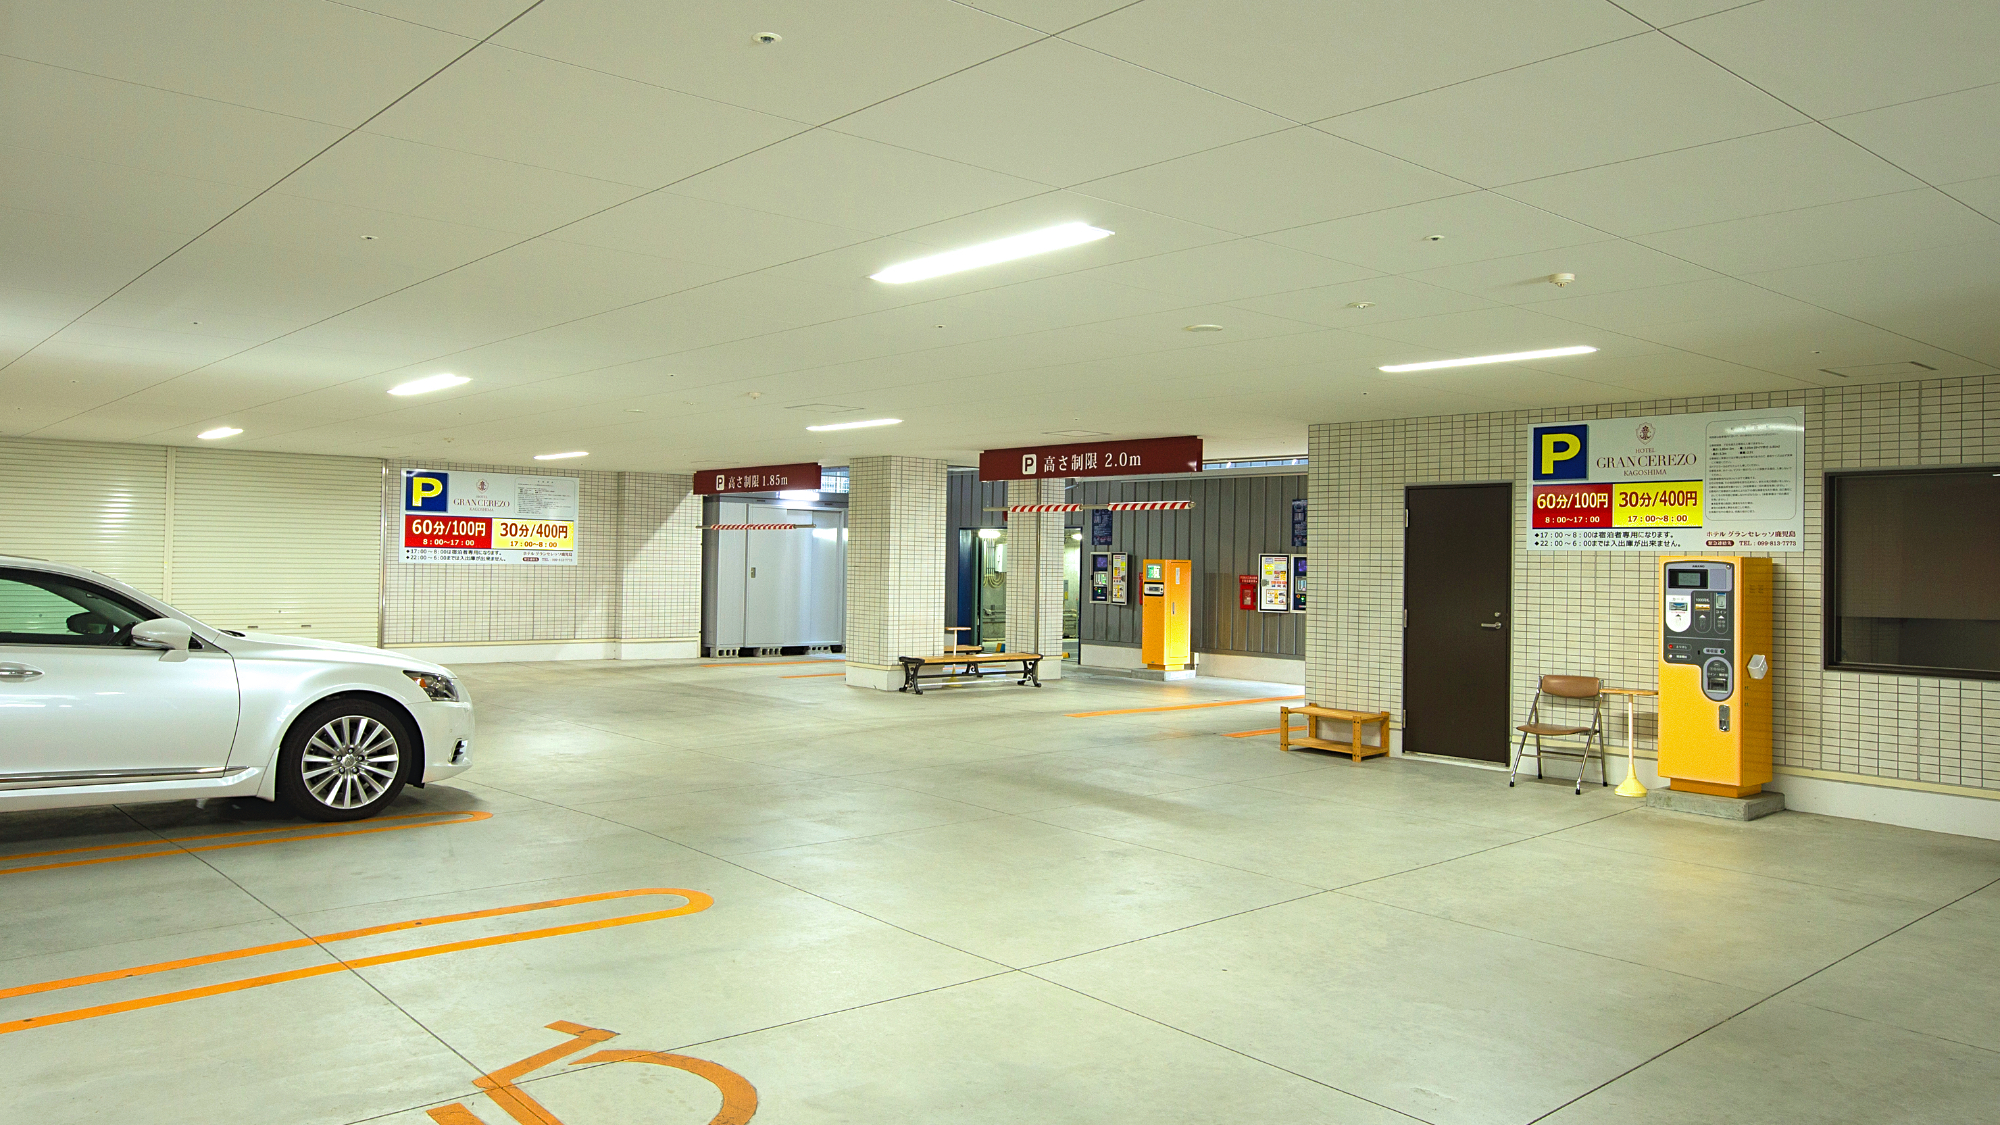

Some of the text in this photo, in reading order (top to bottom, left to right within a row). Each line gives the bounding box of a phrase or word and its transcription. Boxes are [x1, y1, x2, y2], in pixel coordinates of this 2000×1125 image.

[1044, 452, 1142, 473] 高さ制限 2.0m
[1541, 433, 1581, 474] P
[728, 474, 788, 489] 高さ制限 1.85m
[412, 476, 443, 507] P
[1618, 490, 1698, 508] 30分/400円
[1536, 492, 1609, 510] 60分/100円
[412, 519, 486, 537] 60分/100円
[500, 522, 568, 539] 30分/400円
